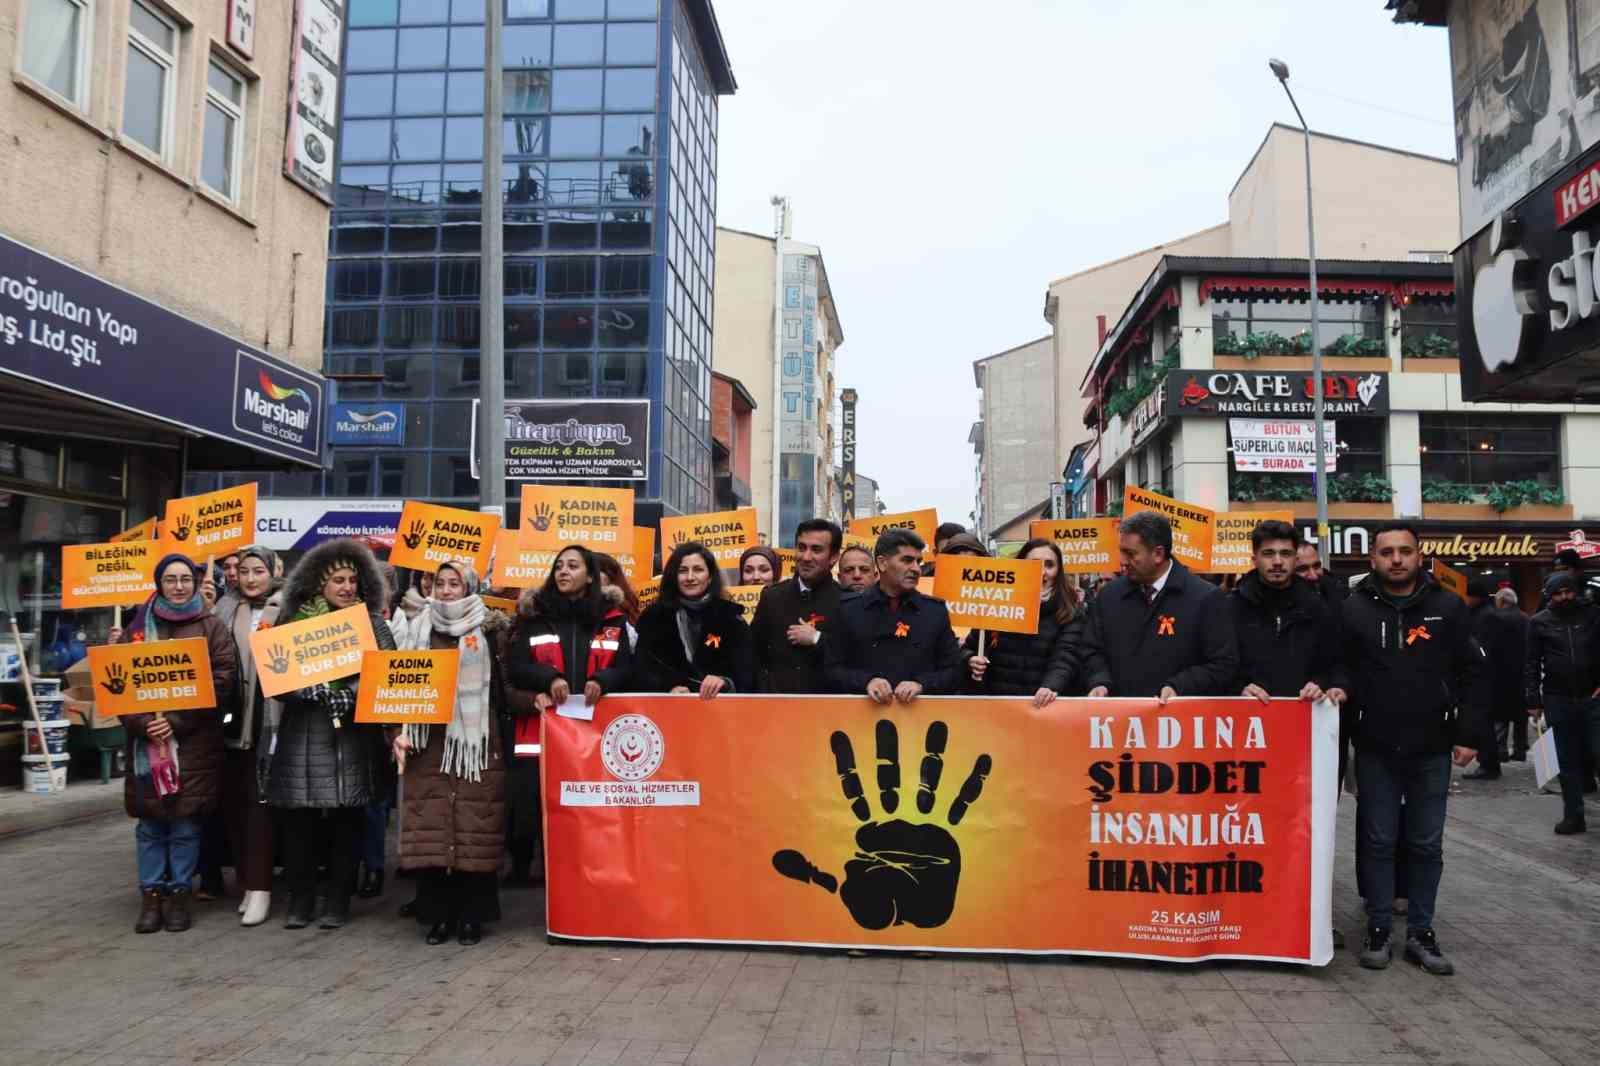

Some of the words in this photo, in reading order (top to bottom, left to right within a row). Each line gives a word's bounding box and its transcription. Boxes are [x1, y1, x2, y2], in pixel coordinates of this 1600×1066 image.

[1548, 230, 1600, 331] st
[95, 306, 138, 346] Yapı
[29, 318, 102, 368] Ltd.Şti.
[1208, 373, 1292, 400] CAFE
[243, 387, 305, 431] Marshall
[1218, 400, 1271, 413] NARGİLE
[1273, 402, 1281, 412] &
[336, 421, 390, 433] Marshall
[510, 447, 559, 456] Güzellik
[562, 447, 572, 456] &
[576, 447, 614, 456] Bakım
[1287, 440, 1333, 454] MAÇLRI
[1263, 459, 1304, 469] BURADA
[198, 499, 243, 516] KADINA
[559, 500, 617, 512] KADINA
[1130, 493, 1160, 511] KADIN
[1162, 502, 1176, 514] VE
[1177, 506, 1209, 524] ERKEK
[196, 512, 244, 532] ŞİDDETE
[256, 518, 297, 532] CELL
[433, 519, 481, 537] KADINA
[557, 515, 619, 528] ŞİDDETE
[694, 522, 743, 536] KADINA
[196, 533, 221, 545] DUR
[223, 527, 242, 540] DE!
[559, 530, 590, 541] DUR
[593, 531, 616, 542] DE!
[1054, 527, 1098, 538] KADES
[1216, 530, 1253, 543] ŞİDDE
[427, 533, 480, 552] ŞİDDETE
[1420, 534, 1538, 562] vukçuluk
[85, 546, 147, 560] BİLEĞİNİN
[1061, 552, 1110, 564] RTARIR
[962, 567, 1016, 585] KADES
[960, 584, 1014, 601] HAYAT
[947, 601, 1025, 620] KURTARIR
[292, 621, 353, 645] KADINA
[295, 634, 359, 664] ŞİDDETE
[132, 653, 192, 669] KADINA
[301, 659, 333, 676] DUR
[335, 652, 362, 669] DE!
[389, 659, 433, 669] KADINA
[131, 667, 197, 686] ŞİDDETE
[136, 688, 169, 700] DUR
[173, 685, 198, 698] DE!
[375, 685, 439, 699] İNSANLIĞA
[1089, 716, 1267, 749] KADINA
[1087, 752, 1267, 803] ŞİDDET
[565, 783, 586, 793] AİLE
[589, 783, 601, 793] VE
[603, 784, 638, 794] SOSYAL
[1089, 803, 1266, 846] İNSANLIĞA
[1088, 851, 1264, 895] İHANETTİR
[1151, 910, 1169, 923] 25
[1174, 910, 1221, 924] KASIM
